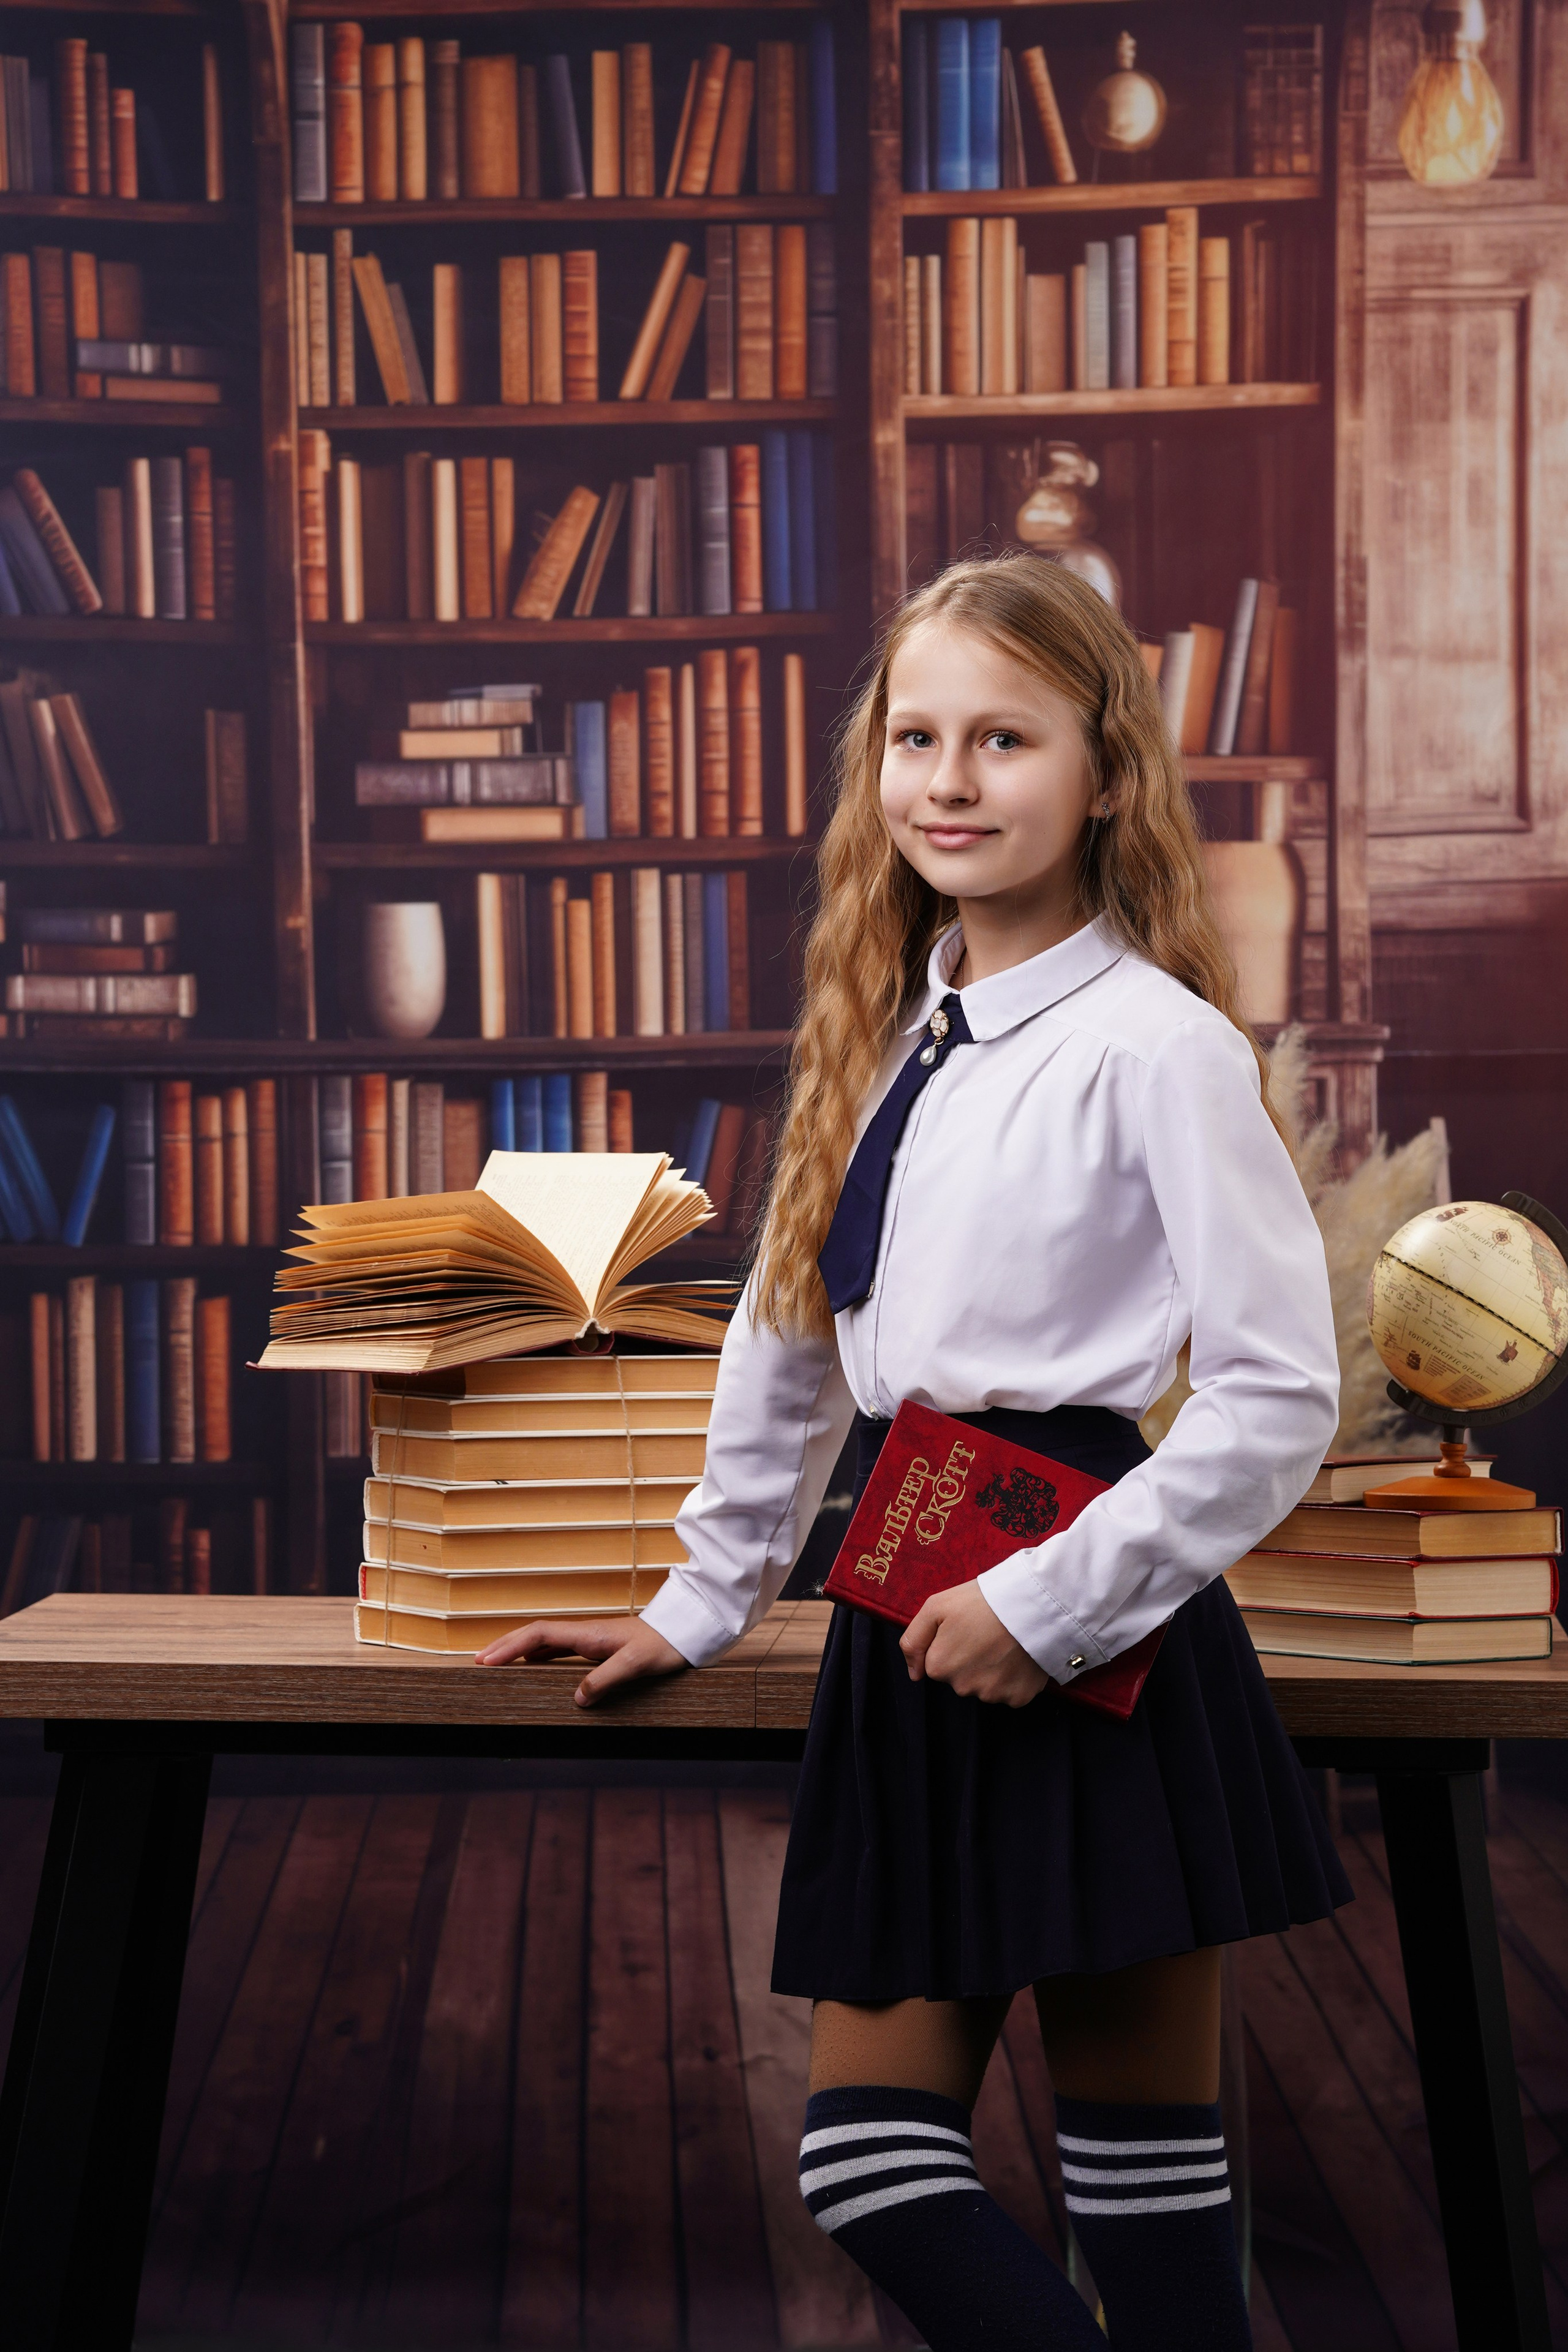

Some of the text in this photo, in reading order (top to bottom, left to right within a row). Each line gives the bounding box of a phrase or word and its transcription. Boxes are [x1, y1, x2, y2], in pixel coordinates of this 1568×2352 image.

[1449, 1219, 1469, 1232] NORTH
[1471, 1232, 1497, 1250] PACIFIC
[1498, 1250, 1521, 1265] OCEAN
[1408, 1330, 1431, 1347] SOUTH
[1432, 1346, 1461, 1365] PACIFIC
[1462, 1365, 1485, 1381] OCEAN
